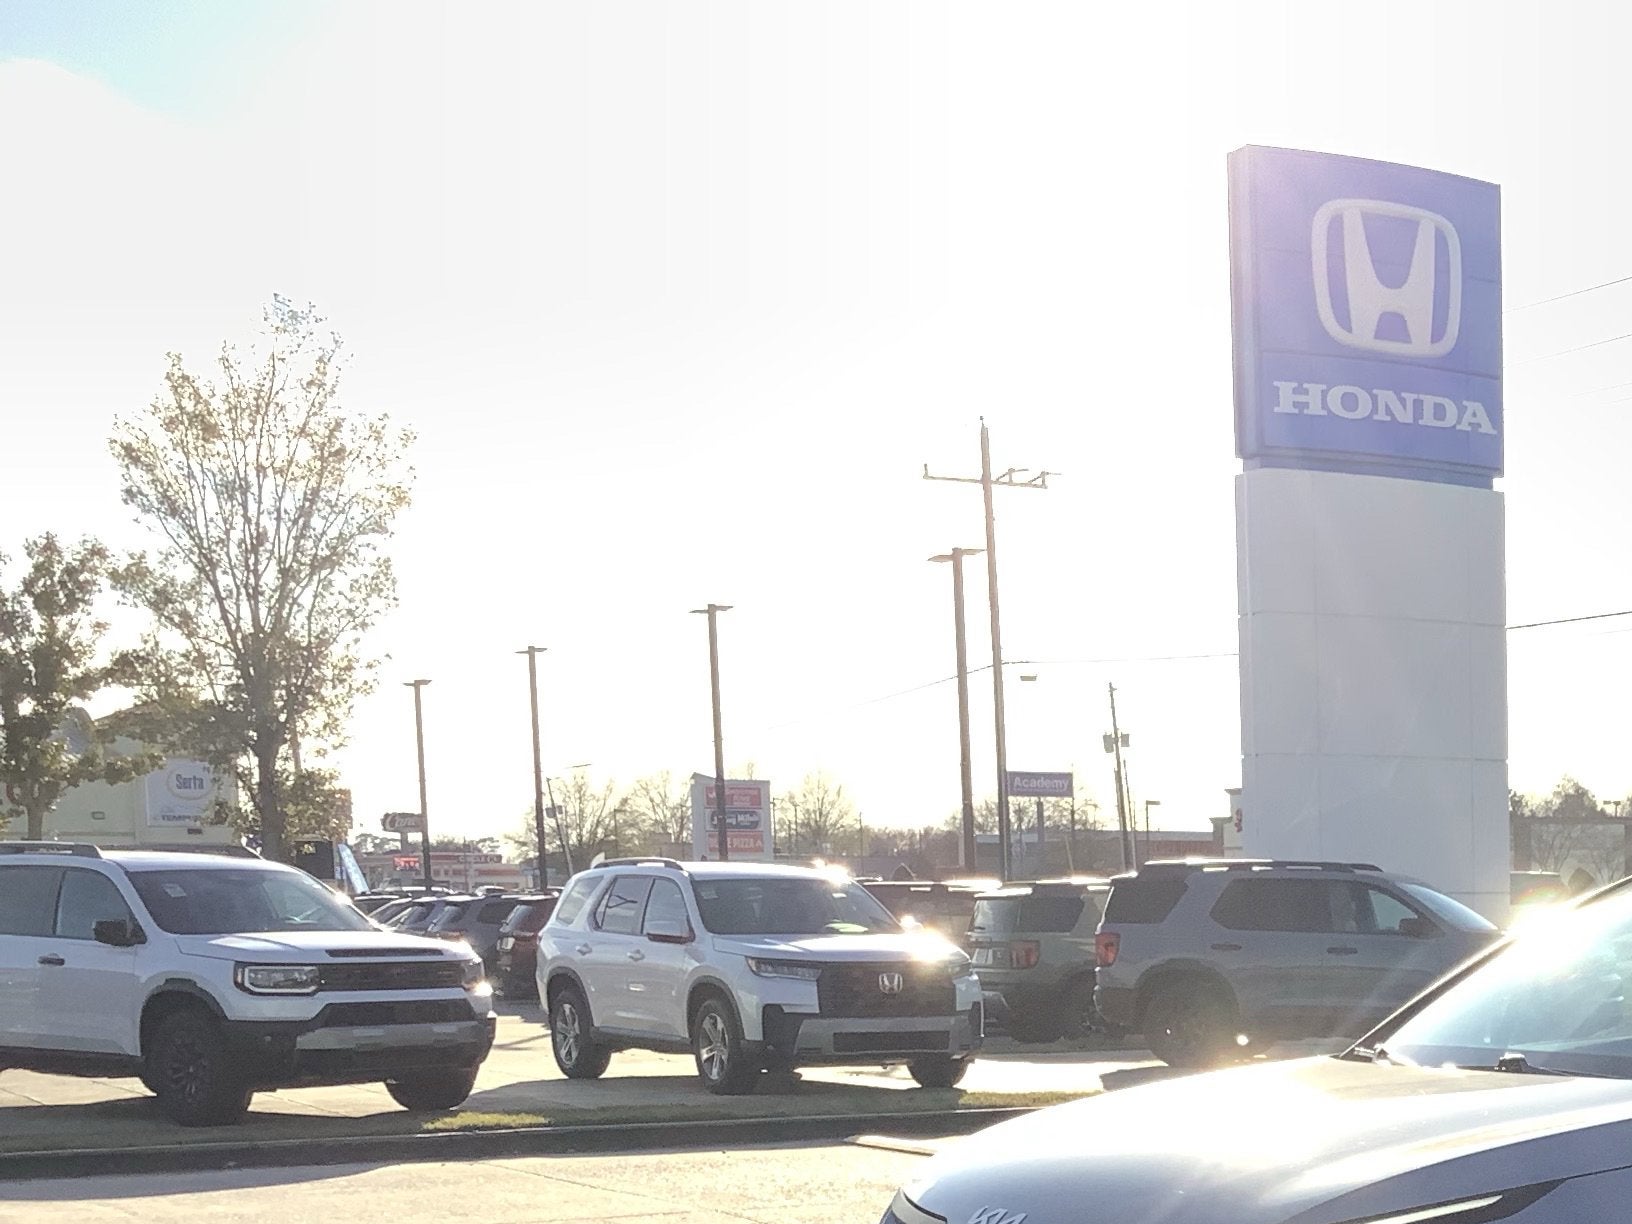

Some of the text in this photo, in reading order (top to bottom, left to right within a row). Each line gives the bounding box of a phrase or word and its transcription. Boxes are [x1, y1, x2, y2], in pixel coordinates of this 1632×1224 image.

[1273, 379, 1498, 435] HONDA
[176, 774, 204, 790] Serta
[1014, 776, 1069, 792] Academy
